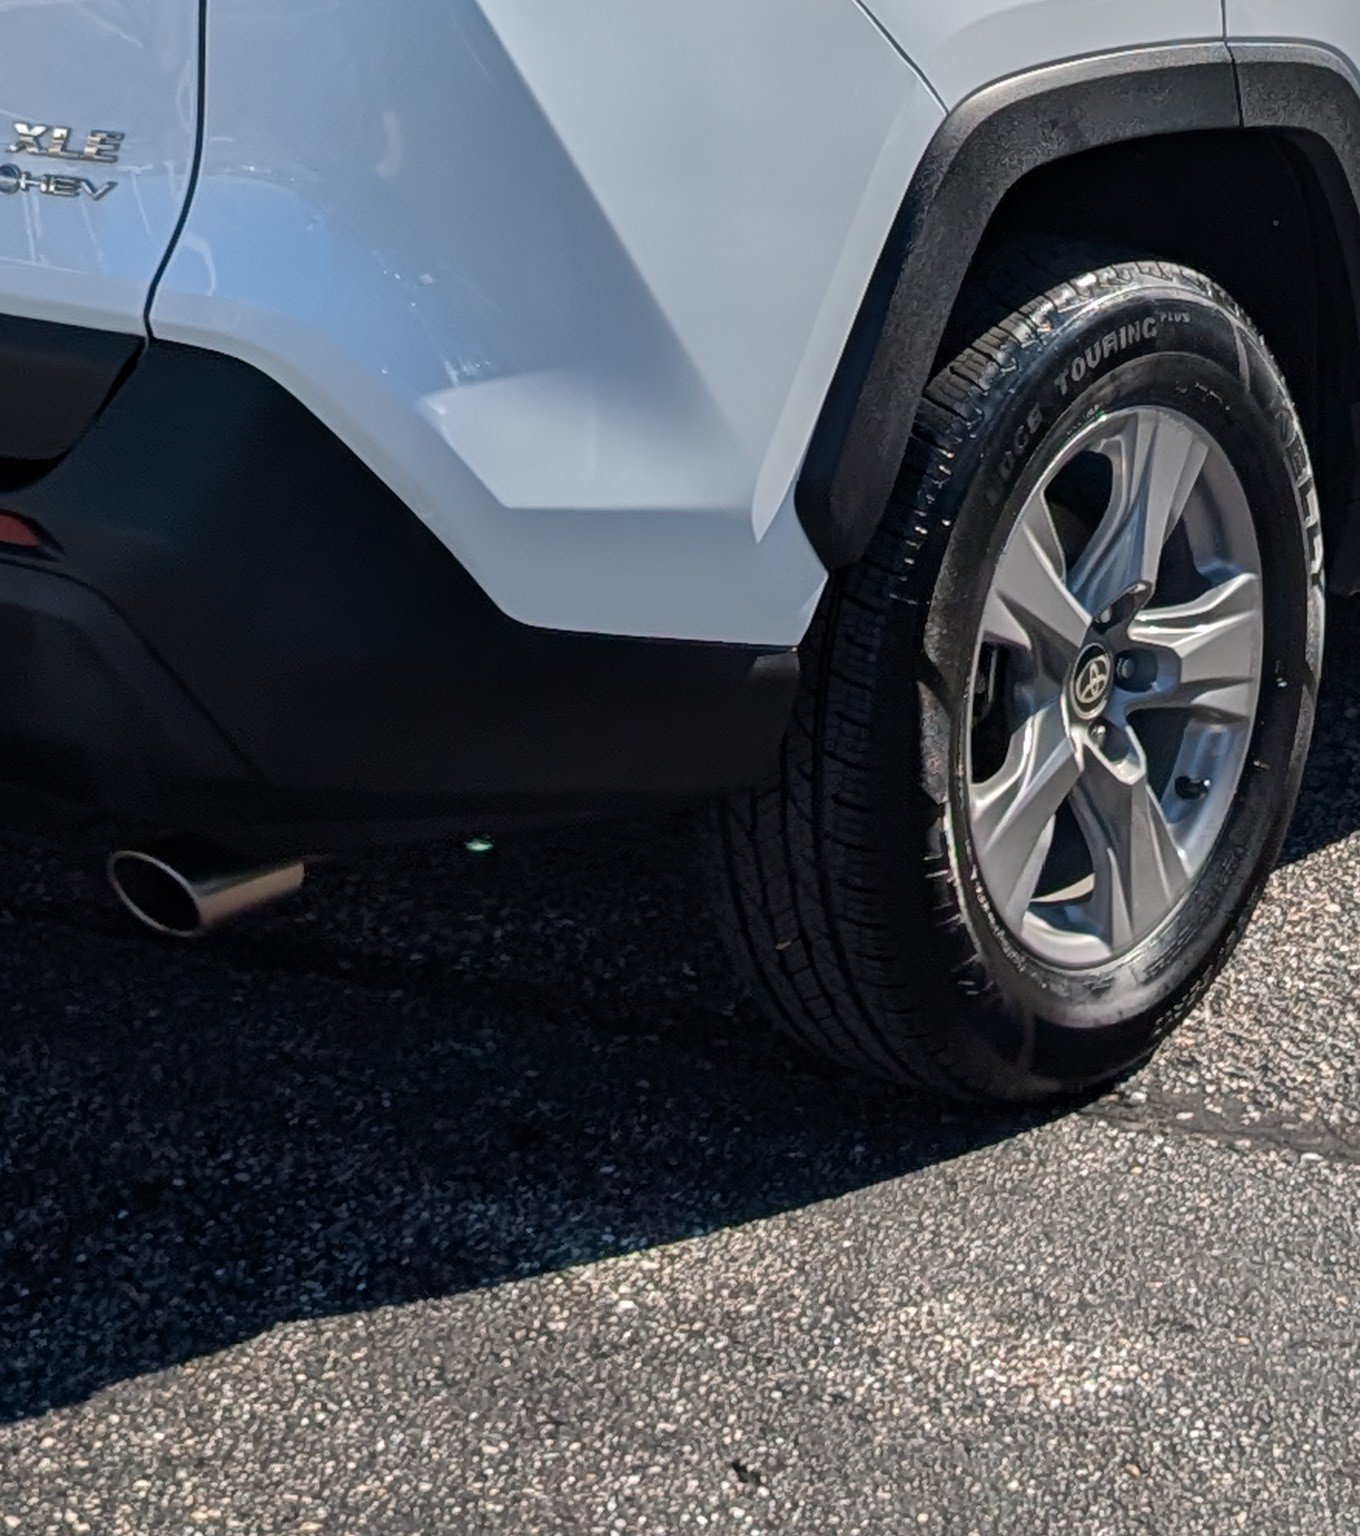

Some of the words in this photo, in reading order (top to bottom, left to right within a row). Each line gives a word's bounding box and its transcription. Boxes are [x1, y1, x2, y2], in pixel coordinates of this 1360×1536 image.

[5, 121, 126, 163] XLE
[19, 171, 119, 201] HEV
[1053, 316, 1159, 396] TOURING
[1159, 310, 1191, 323] PLUS
